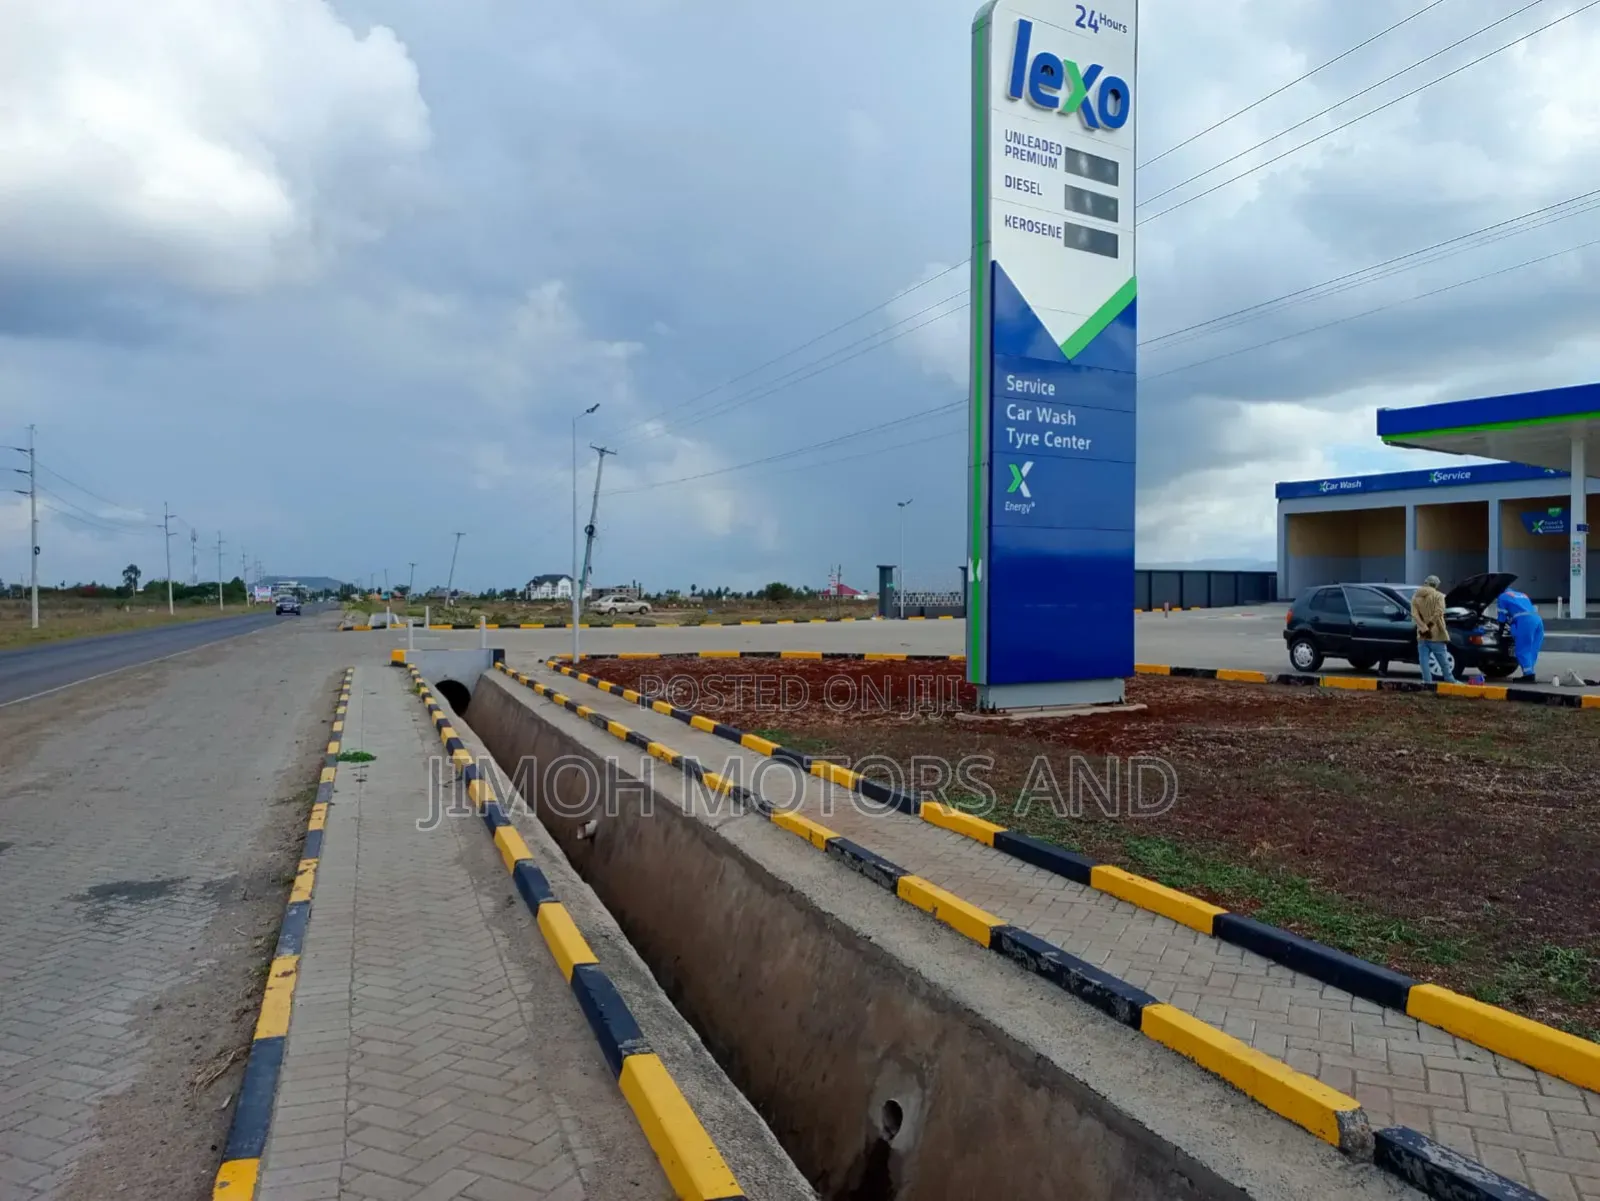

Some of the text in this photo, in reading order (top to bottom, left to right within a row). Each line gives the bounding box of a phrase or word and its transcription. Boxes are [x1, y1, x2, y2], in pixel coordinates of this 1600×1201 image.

[1075, 4, 1128, 34] 24 Hours
[1008, 18, 1131, 130] lexo
[1005, 129, 1063, 156] UNLEADED
[1005, 145, 1058, 170] PREMIUM
[1005, 175, 1043, 196] DIESEL
[1005, 214, 1063, 240] KEROSENE
[1006, 374, 1056, 396] Service
[1006, 404, 1076, 426] Car Wash
[1006, 427, 1092, 450] Tyre Center
[1340, 480, 1362, 490] Wash
